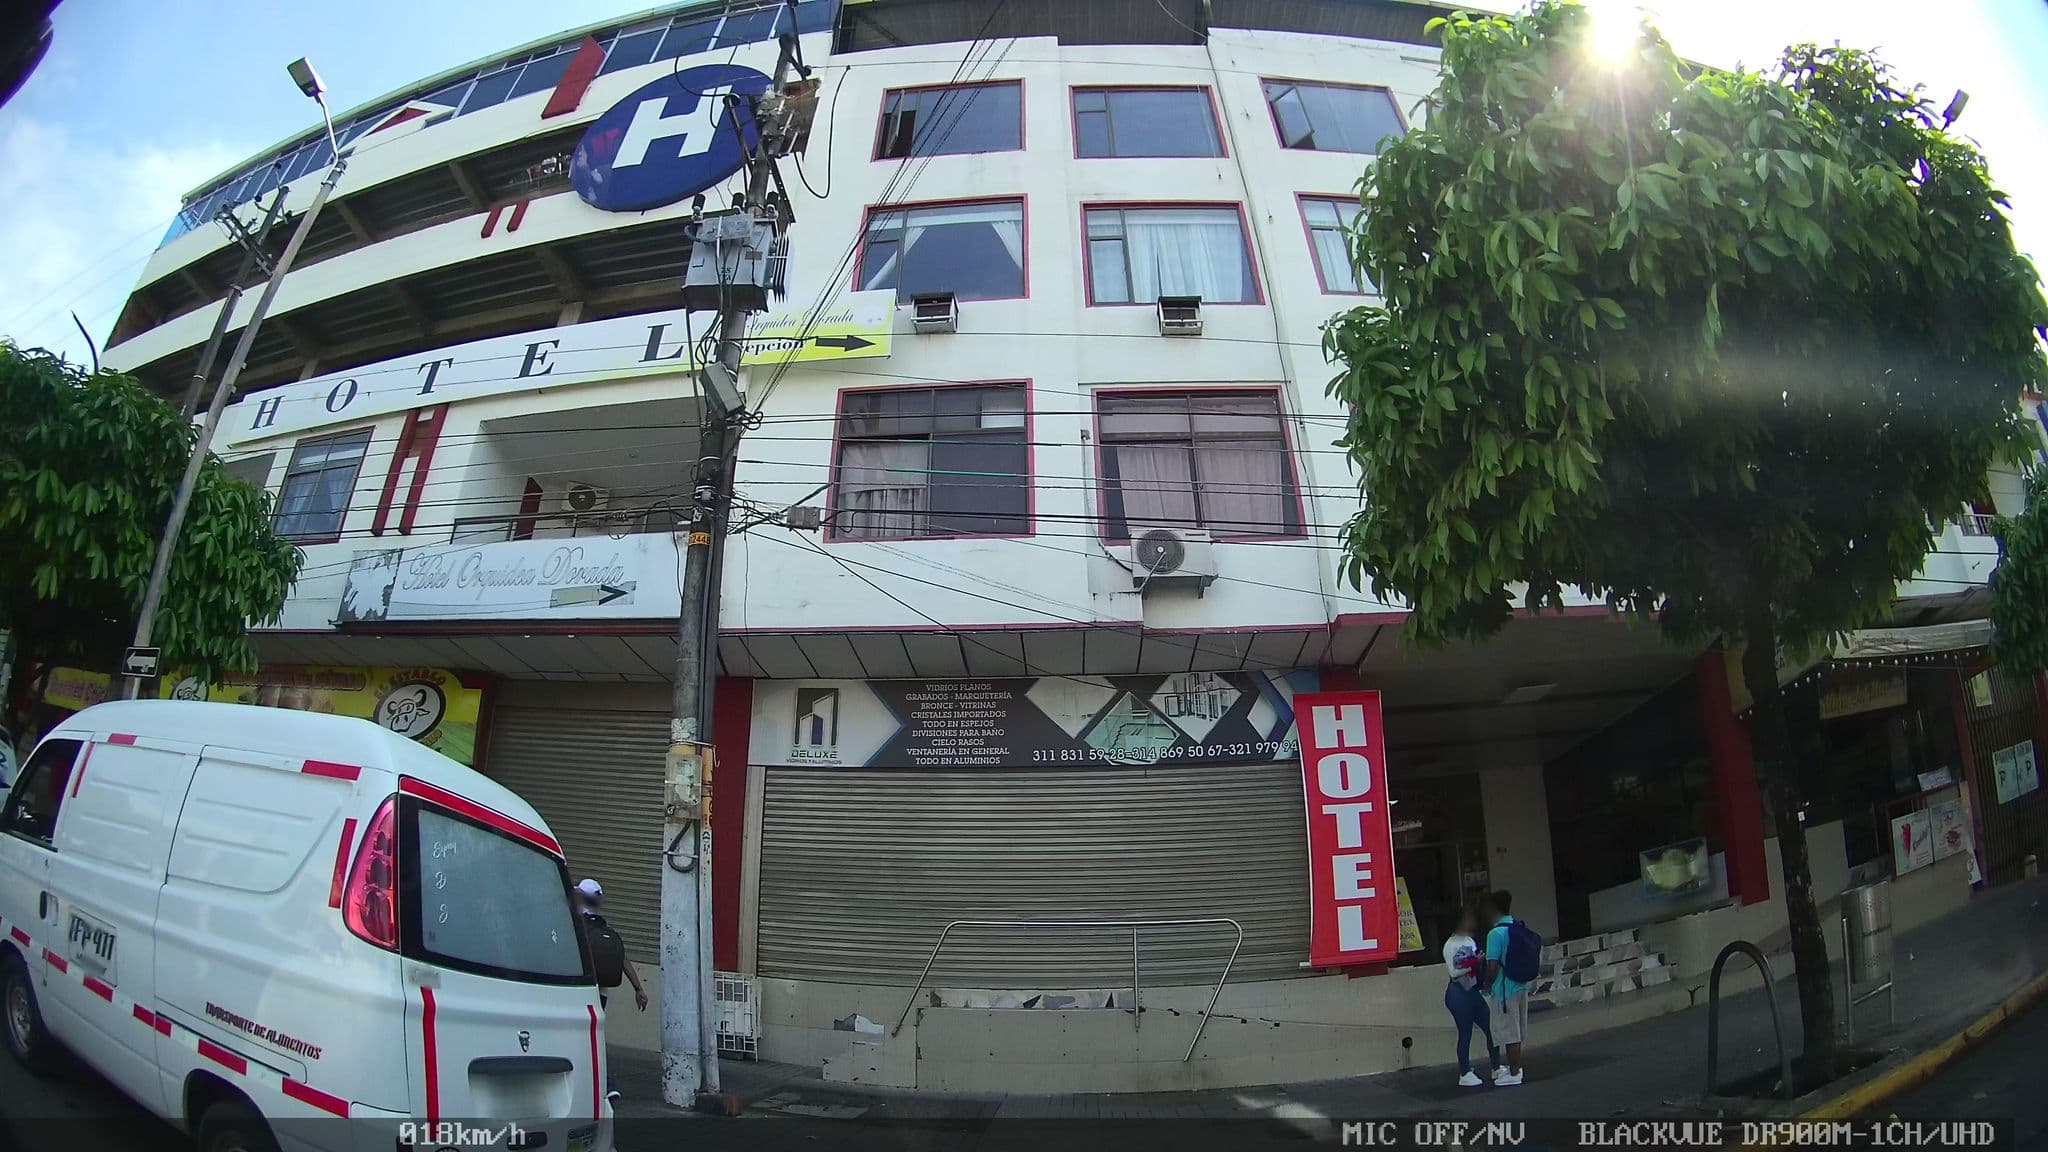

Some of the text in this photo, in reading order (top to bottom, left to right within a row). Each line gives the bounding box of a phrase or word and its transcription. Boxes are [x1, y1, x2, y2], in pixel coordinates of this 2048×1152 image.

[612, 84, 733, 169] H
[248, 323, 685, 431] HOTEL
[457, 551, 537, 601] Orquidea
[537, 545, 625, 587] Dorada
[960, 683, 992, 691] PLANOS
[905, 693, 949, 701] GRABADOS
[921, 701, 997, 710] BRONCE VITRINAS
[911, 710, 1007, 719] CRISTALES IMPORTADOS
[922, 719, 995, 728] TODO EN ESPEJOS
[912, 729, 958, 737] DIVISIONES
[959, 729, 980, 737] PARA
[958, 738, 985, 746] RASOS
[791, 749, 838, 759] DELUXE
[971, 747, 1010, 755] GENERAL
[1032, 750, 1055, 761] 311
[1060, 749, 1084, 761] 831
[1160, 747, 1184, 759] 869
[1187, 745, 1204, 758] 50
[1207, 743, 1251, 756] 67-321
[1255, 741, 1279, 754] 979
[915, 756, 1001, 765] TODO EN ALUMINIOS
[1311, 703, 1378, 953] HOTEL
